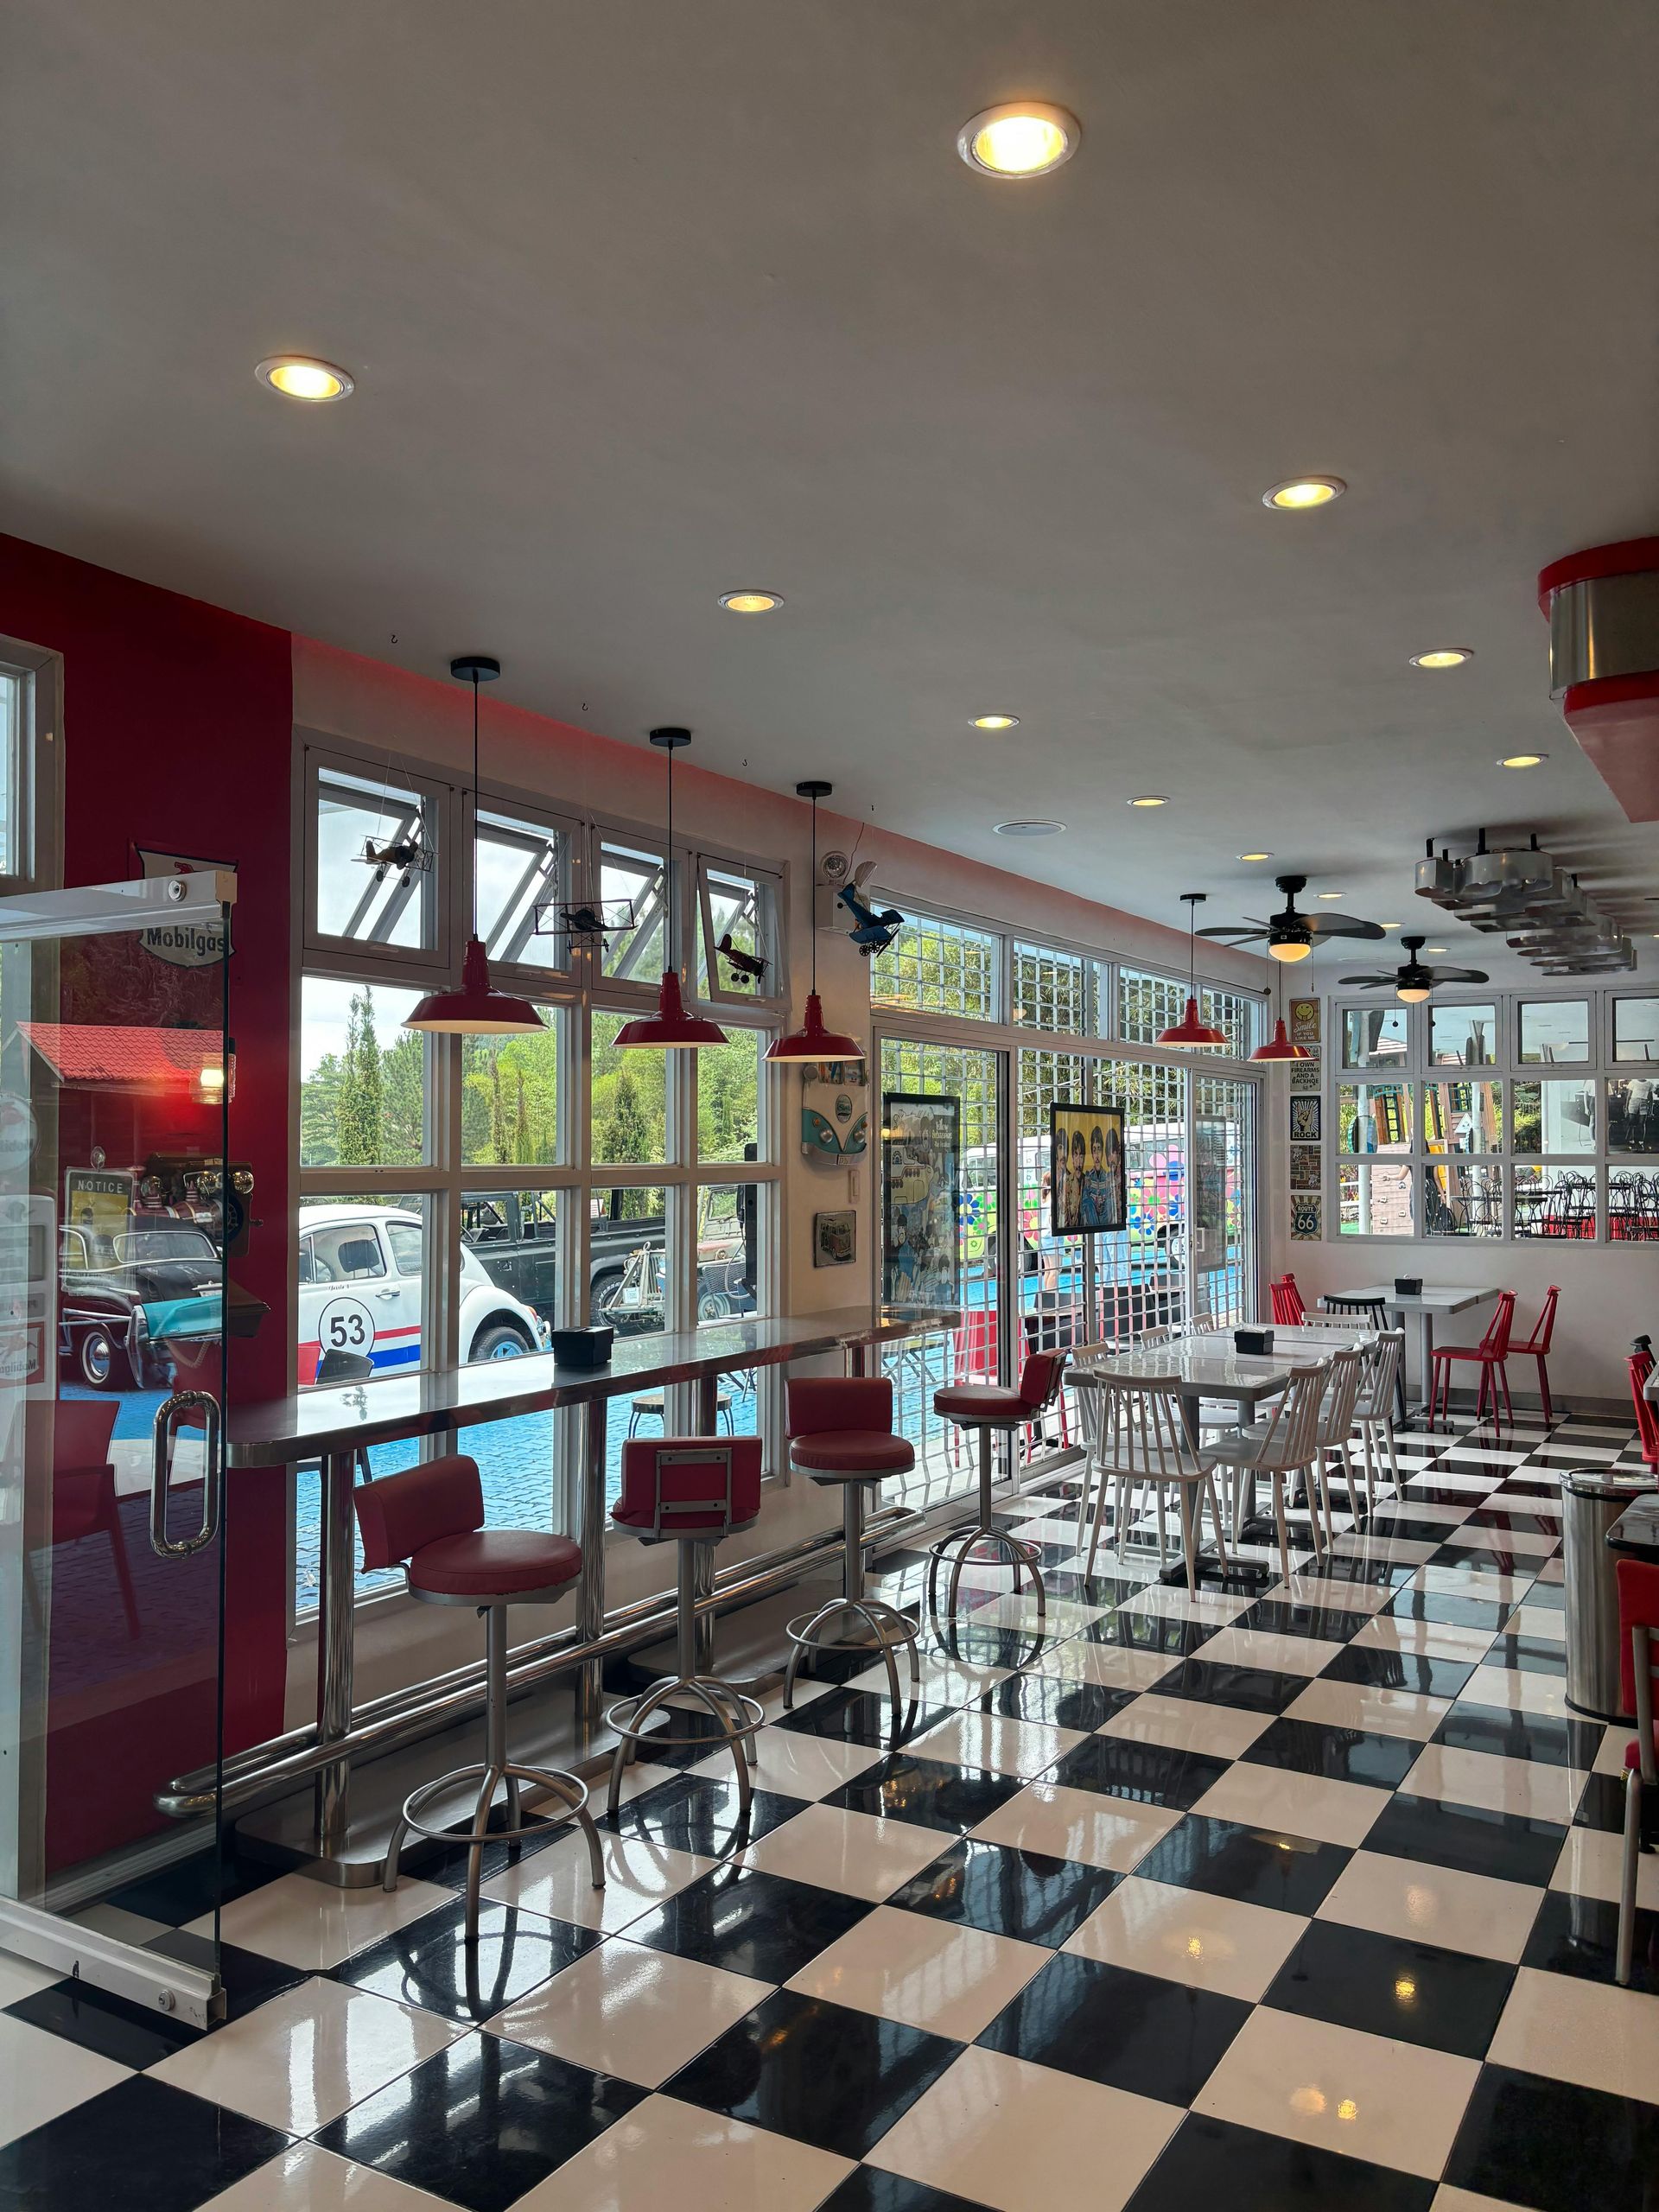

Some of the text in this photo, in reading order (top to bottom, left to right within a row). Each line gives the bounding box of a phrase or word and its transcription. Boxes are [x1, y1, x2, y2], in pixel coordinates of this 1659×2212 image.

[147, 925, 226, 957] Mobilgas
[1294, 1020, 1317, 1033] Smile
[78, 1180, 123, 1193] NOTICE
[1298, 1215, 1314, 1230] 66
[331, 1314, 365, 1347] 53
